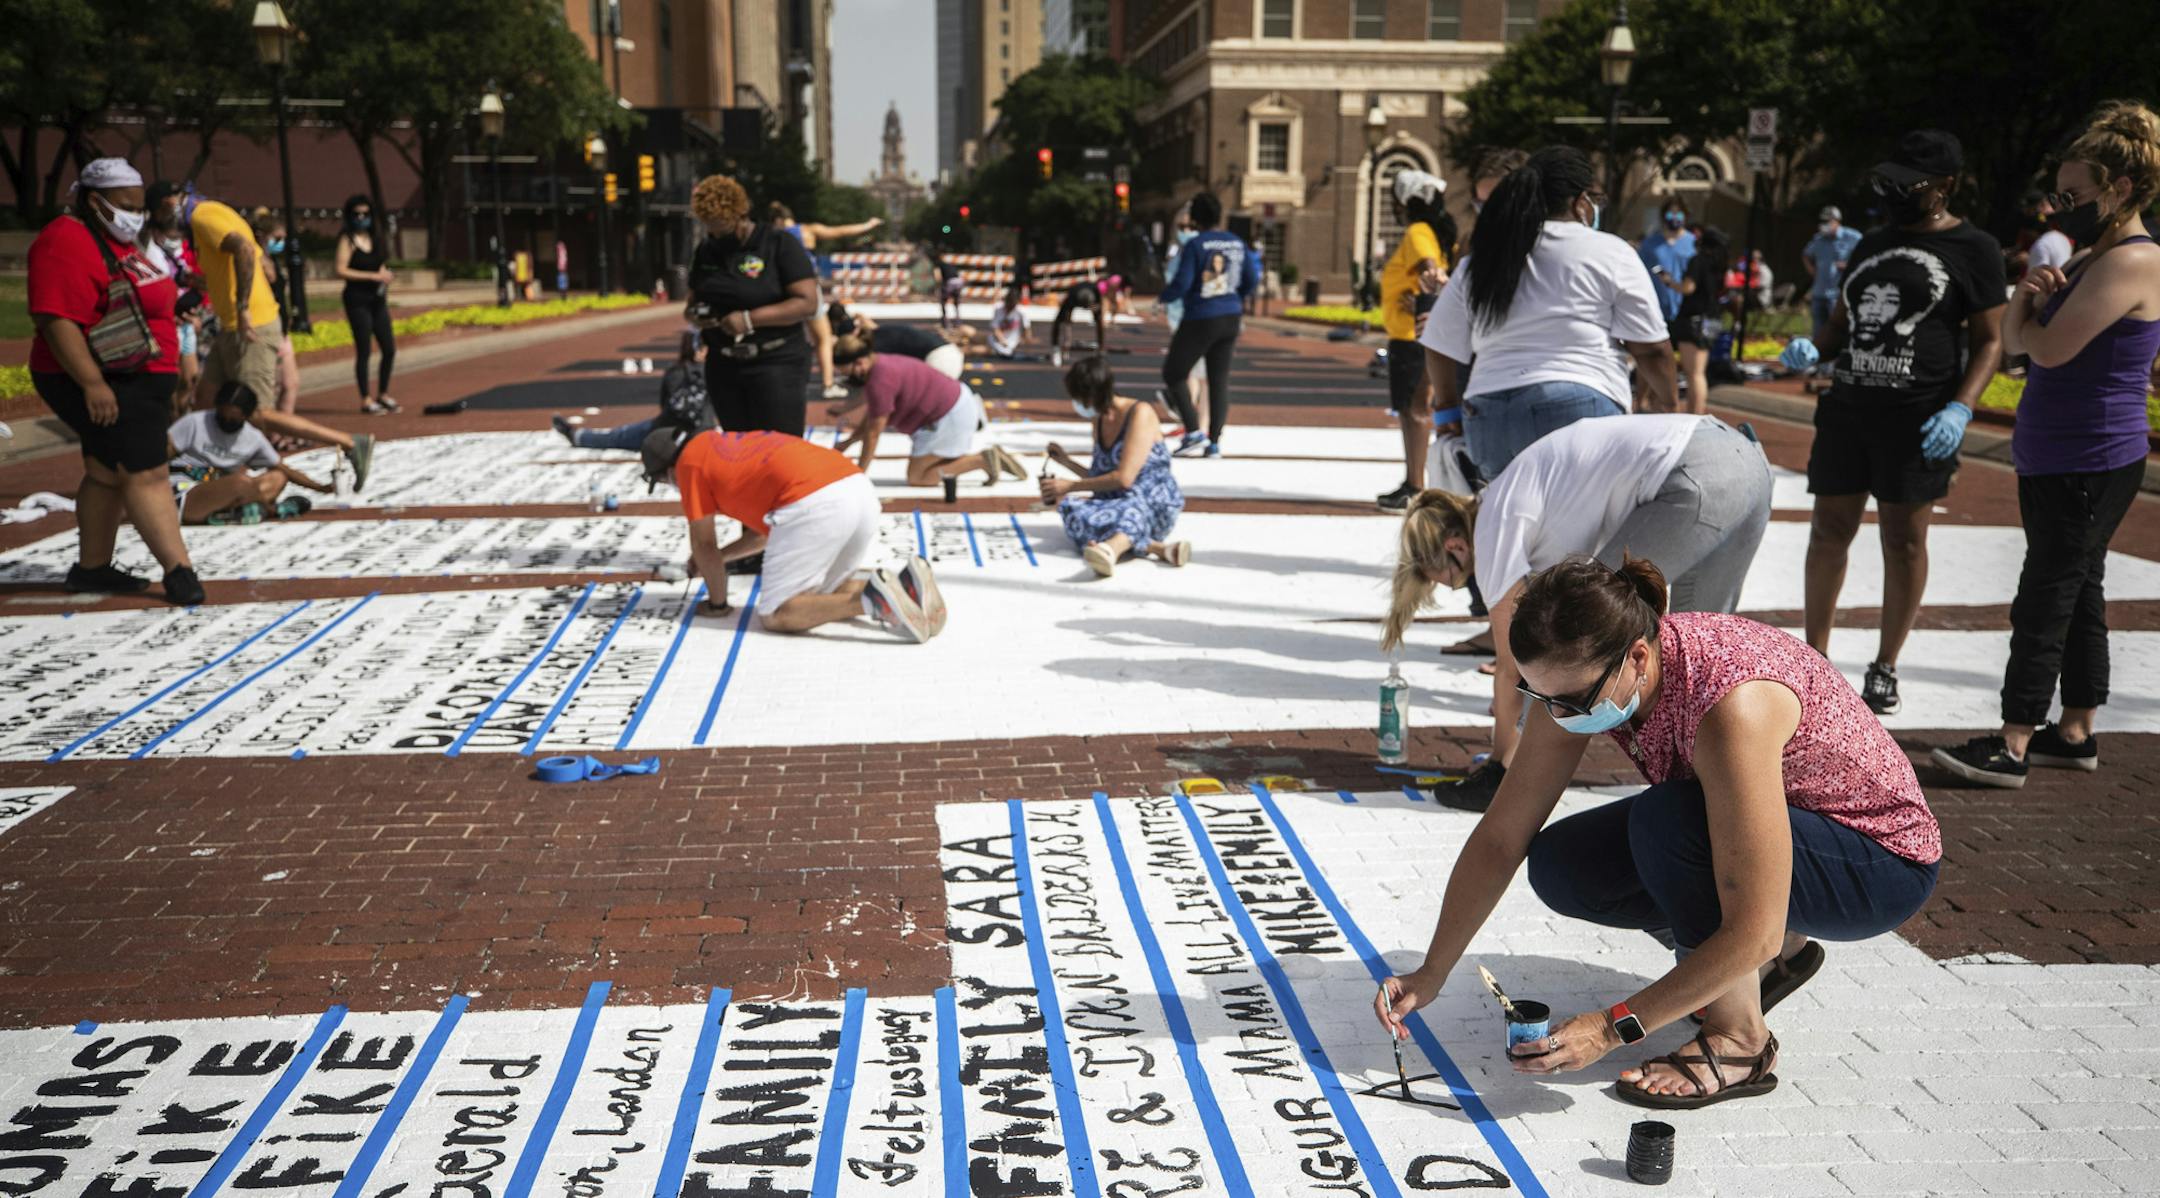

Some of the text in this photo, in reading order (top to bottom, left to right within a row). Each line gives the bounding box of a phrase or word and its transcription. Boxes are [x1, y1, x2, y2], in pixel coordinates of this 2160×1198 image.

[1852, 354, 1913, 375] HENDRIX
[464, 700, 548, 746] UAW
[1196, 803, 1294, 871] EMILY
[1185, 931, 1250, 976] ALL
[1236, 887, 1344, 955] MIKE
[943, 833, 1064, 1198] FAMILY SARA
[1221, 984, 1303, 1082] MAMA
[680, 1004, 840, 1198] FAMILY
[1106, 1092, 1175, 1126] &
